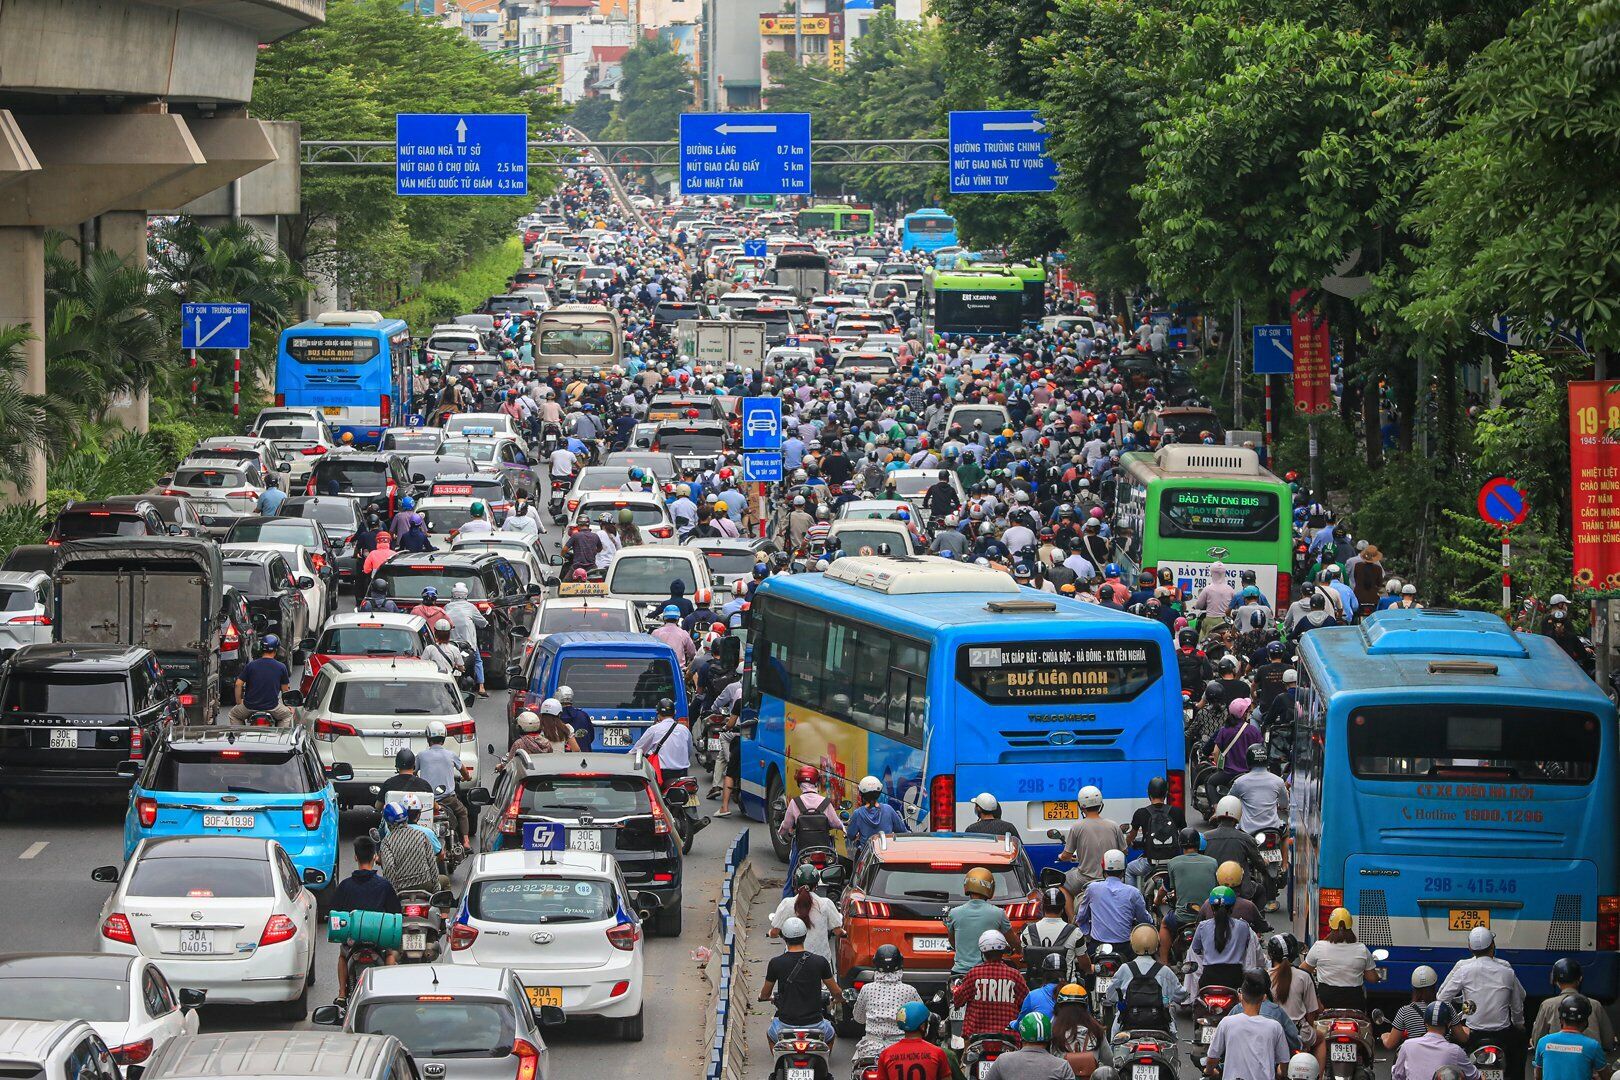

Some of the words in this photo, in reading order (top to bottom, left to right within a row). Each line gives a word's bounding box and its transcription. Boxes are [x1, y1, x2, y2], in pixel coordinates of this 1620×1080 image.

[400, 143, 415, 156] NÚT
[418, 146, 434, 156] GIAO
[438, 144, 454, 156] NGÃ
[457, 146, 467, 156] TƯ
[470, 143, 482, 156] SỞ
[686, 143, 712, 154] ĐƯỜNG
[716, 143, 736, 154] LÁNG
[792, 146, 804, 154] km
[954, 140, 980, 153] ĐƯỜNG
[984, 140, 1014, 153] TRƯỜNG
[1018, 142, 1040, 152] CHINH
[400, 160, 415, 172] NÚT
[418, 162, 434, 172] GIAO
[438, 160, 443, 172] Ô
[446, 162, 461, 173] CHỢ
[464, 160, 480, 172] DỪA
[512, 162, 524, 172] km
[686, 160, 702, 171] NÚT
[704, 162, 722, 171] GIAO
[724, 159, 740, 171] CẦU
[742, 159, 760, 171] GIẤY
[784, 162, 789, 171] 5
[792, 162, 804, 171] km
[954, 158, 970, 170] NÚT
[972, 160, 990, 170] GIAO
[992, 158, 1008, 169] NGÃ
[1010, 159, 1020, 168] TƯ
[1023, 159, 1044, 170] VỌNG
[400, 176, 416, 188] VĂN
[418, 176, 436, 188] MIẾU
[438, 176, 458, 188] QUỐC
[461, 176, 471, 188] TỬ
[474, 176, 492, 188] GIÁM
[512, 180, 524, 188] km
[686, 176, 702, 188] CẦU
[704, 176, 725, 189] NHẬT
[728, 176, 743, 188] TÂN
[782, 178, 790, 188] 11
[792, 178, 804, 188] km
[955, 174, 970, 186] CẦU
[973, 174, 992, 186] VĨNH
[994, 176, 1008, 185] TUY
[1582, 466, 1601, 478] NHIỆT
[1604, 466, 1617, 478] LIỆT
[1580, 480, 1598, 490] CHÀO
[1601, 480, 1620, 490] MỪNG
[1178, 493, 1198, 503] BẢO
[1221, 496, 1239, 505] CNG
[1241, 497, 1258, 506] BUS
[1588, 495, 1595, 503] 77
[1598, 494, 1612, 503] NĂM
[1581, 506, 1598, 516] CÁCH
[1601, 508, 1620, 518] MẠNG
[1582, 520, 1604, 530] THÁNG
[1578, 533, 1600, 543] THÀNH
[1603, 533, 1620, 542] CÔNG
[1178, 565, 1197, 576] BẢO
[1199, 565, 1212, 576] YẾ
[1223, 570, 1237, 578] NG
[972, 649, 998, 665] 21A
[1002, 653, 1010, 664] BX
[1011, 651, 1025, 664] GIÁP
[1026, 650, 1038, 663] BÁT
[1042, 649, 1058, 663] CHÙA
[1060, 649, 1072, 664] BỘC
[1076, 649, 1084, 662] HÀ
[1085, 649, 1102, 662] ĐÔNG
[1106, 651, 1114, 661] BX
[1115, 648, 1127, 661] YÊN
[1008, 673, 1034, 686] BUS
[1038, 669, 1068, 685] LIÊN
[1072, 671, 1108, 684] NINH
[56, 730, 70, 738] 30E
[50, 739, 77, 748] 687.16
[604, 736, 629, 745] 211.8
[1018, 778, 1044, 793] 29B
[1417, 784, 1433, 796] CT
[1436, 785, 1452, 797] XE
[1054, 802, 1069, 810] 29B
[1416, 809, 1456, 820] Hotline
[533, 826, 555, 847] G7
[578, 831, 593, 840] 30E
[1424, 877, 1451, 892] 29B
[1467, 879, 1517, 893] 415.46
[189, 931, 207, 940] 30A
[919, 940, 945, 948] 30H-4
[533, 988, 550, 996] 30A
[974, 979, 1016, 1003] STRIKE
[895, 1063, 926, 1080] 10
